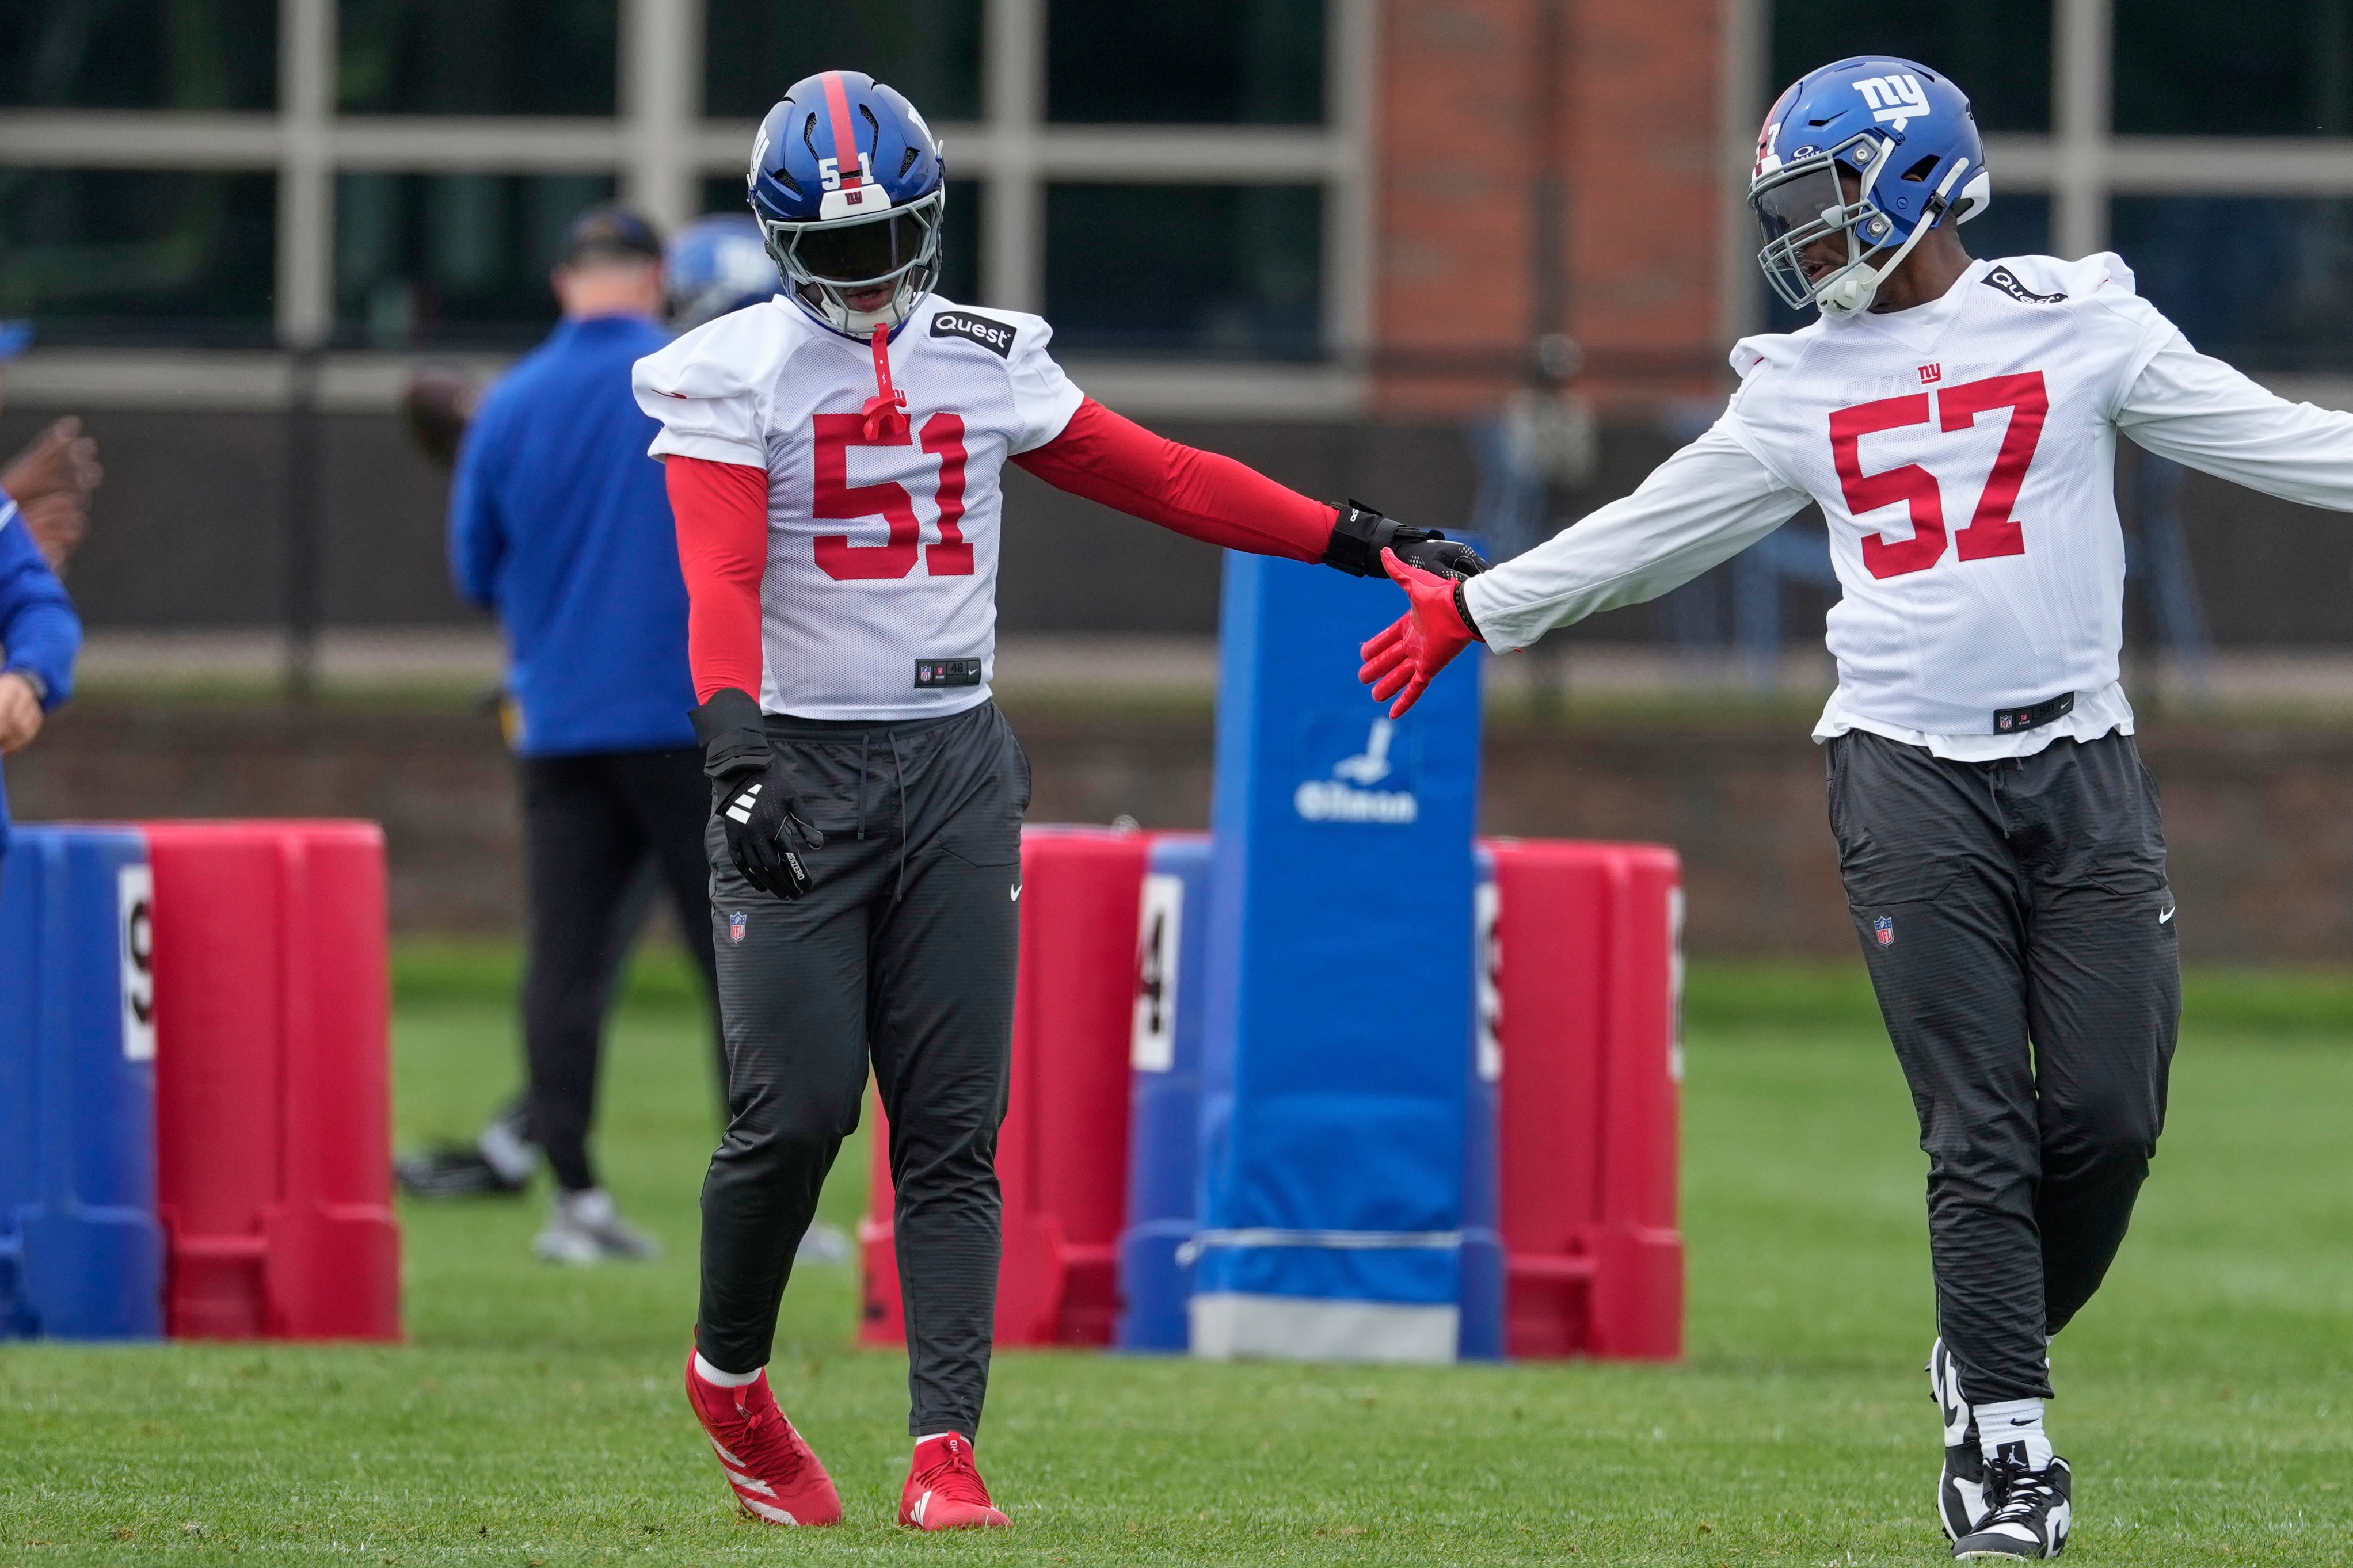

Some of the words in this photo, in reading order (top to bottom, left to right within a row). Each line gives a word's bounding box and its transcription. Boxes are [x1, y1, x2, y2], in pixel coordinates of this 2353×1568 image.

[1852, 75, 1930, 132] ny
[819, 152, 874, 190] 51
[936, 315, 1008, 348] Quest
[1918, 363, 1941, 384] ny
[1829, 370, 2049, 580] 57
[813, 412, 974, 581] 51
[785, 852, 805, 880] ADIZERO
